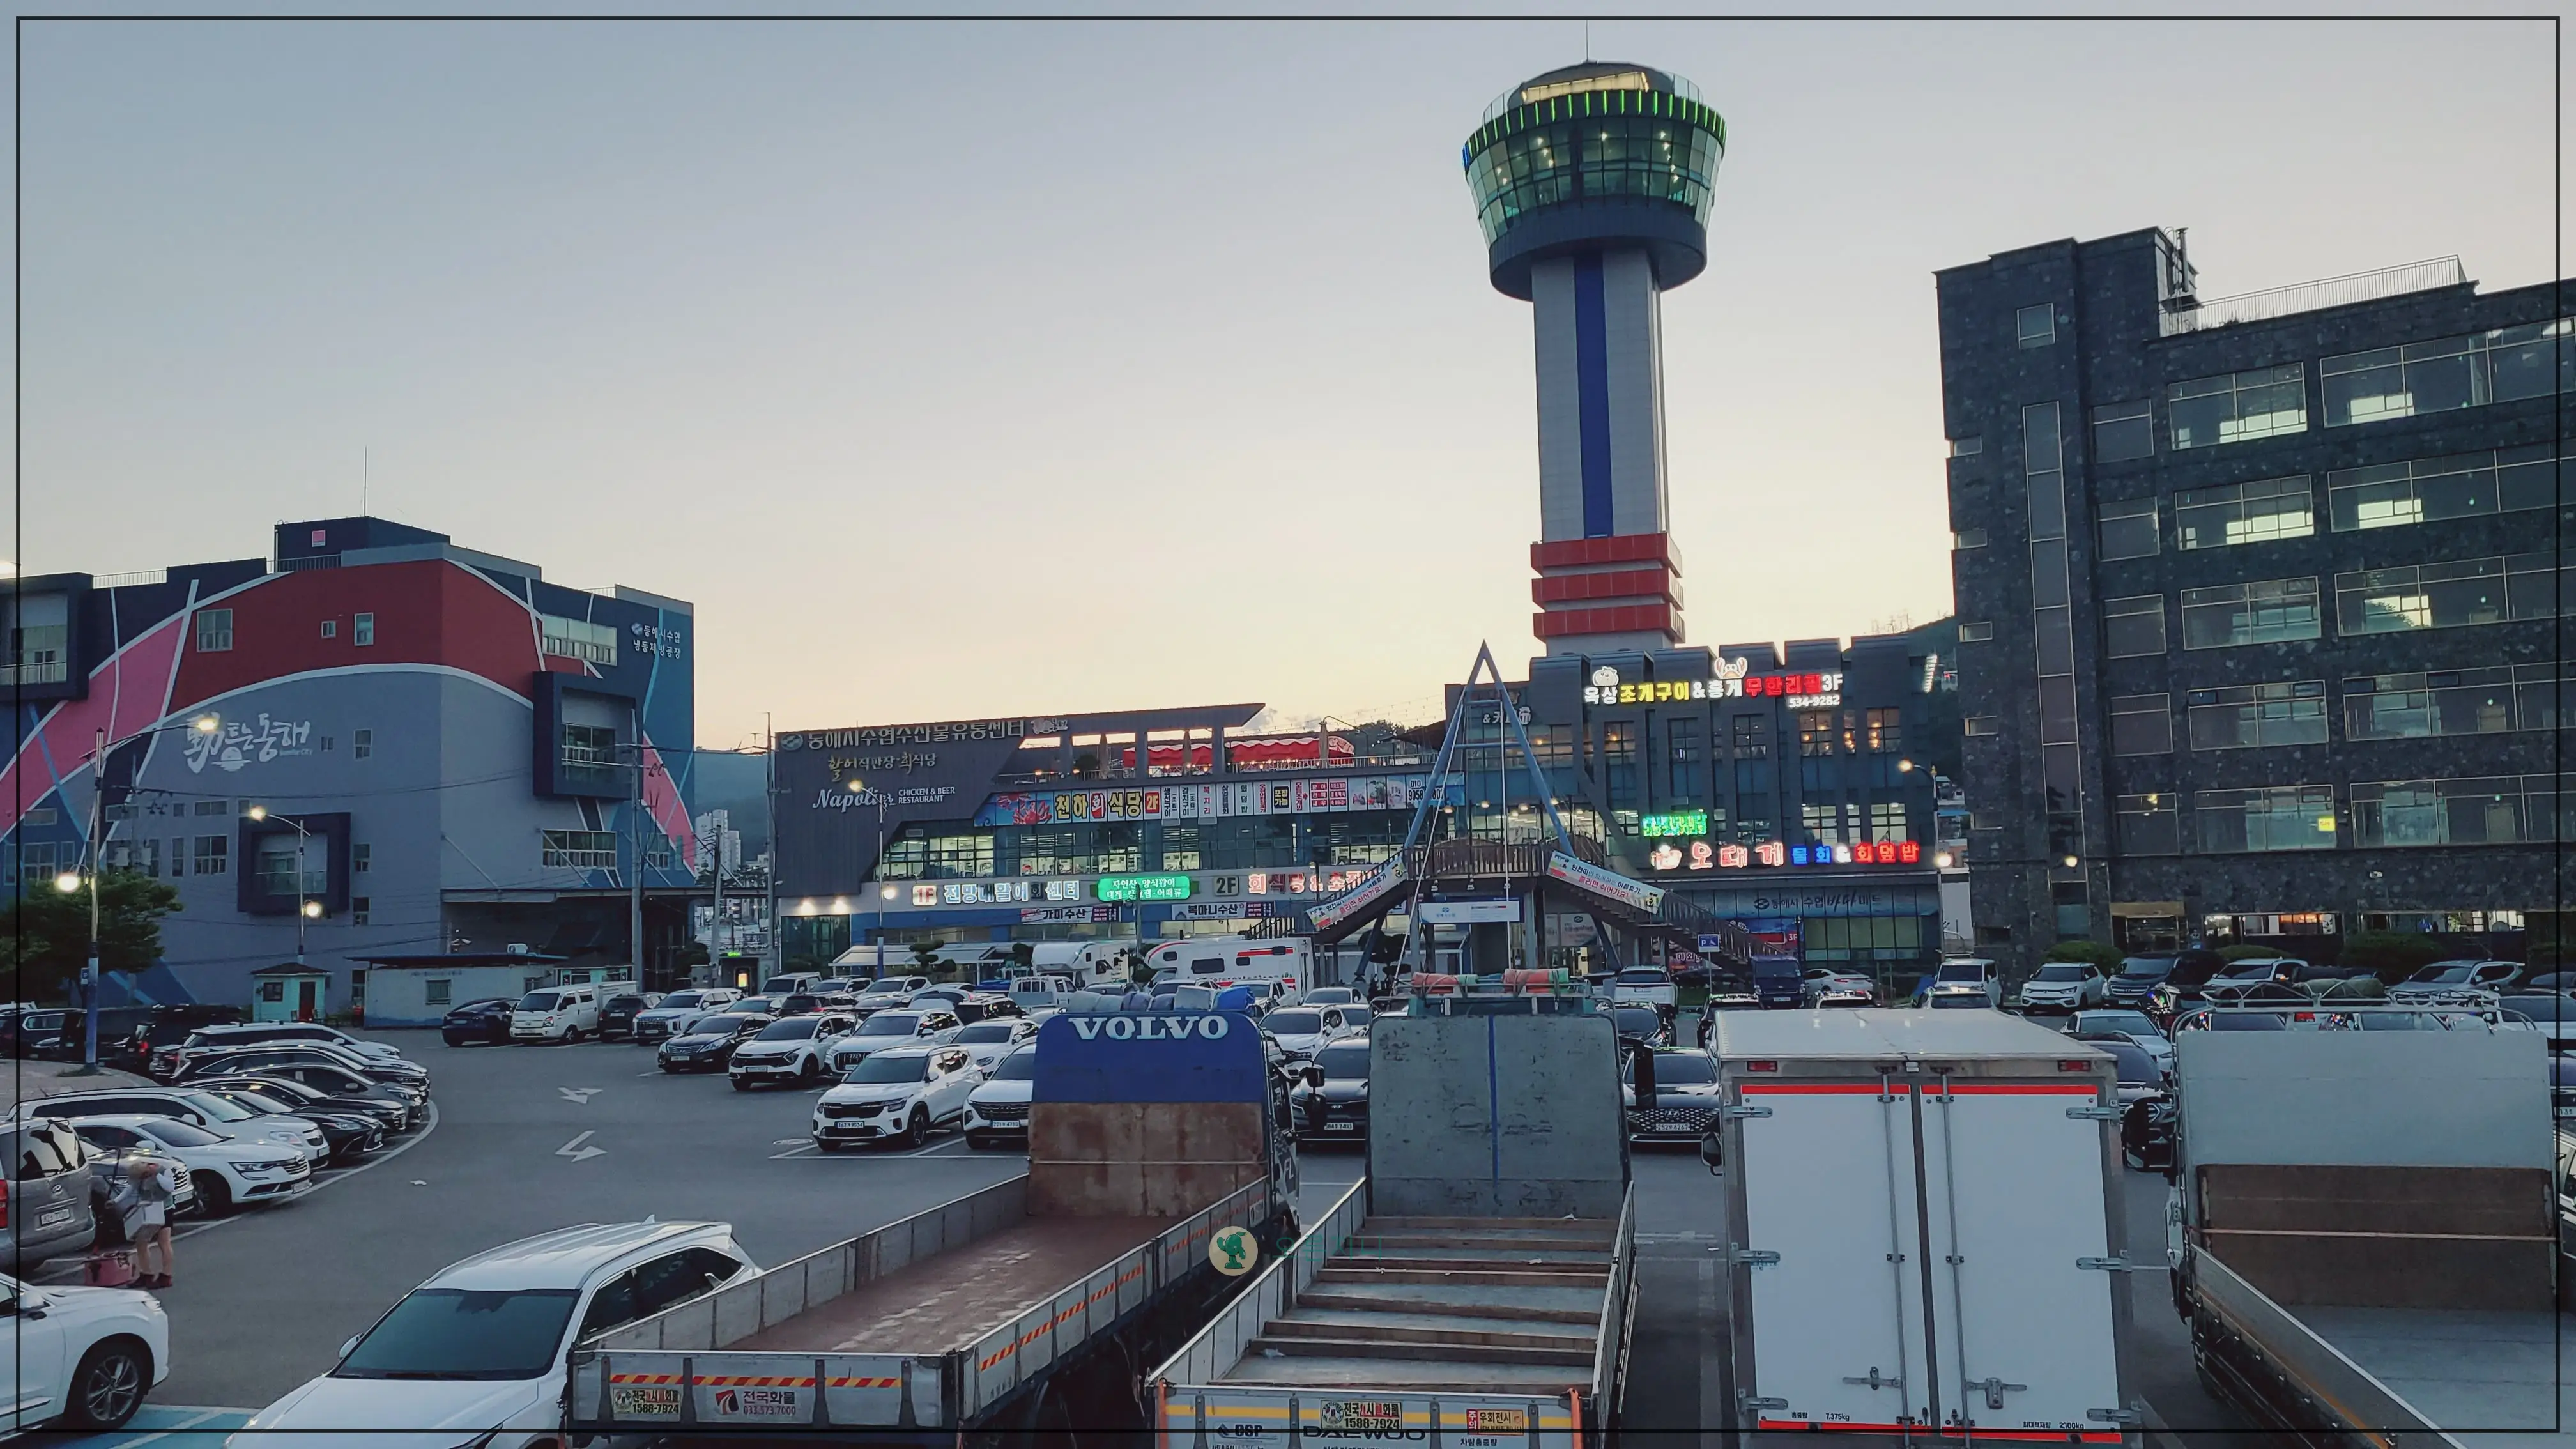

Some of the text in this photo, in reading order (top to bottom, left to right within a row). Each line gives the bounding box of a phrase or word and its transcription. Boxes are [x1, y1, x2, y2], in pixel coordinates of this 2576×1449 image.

[1788, 694, 1841, 709] 534-9282
[1410, 779, 1422, 788] 010
[938, 786, 956, 795] BEER
[1408, 790, 1423, 801] 9058
[898, 795, 944, 804] RESTAURANT
[1216, 877, 1237, 894] 2F
[916, 887, 935, 903] 1F
[1068, 1015, 1229, 1040] VOLVO
[1344, 1418, 1400, 1430] 1588-7924
